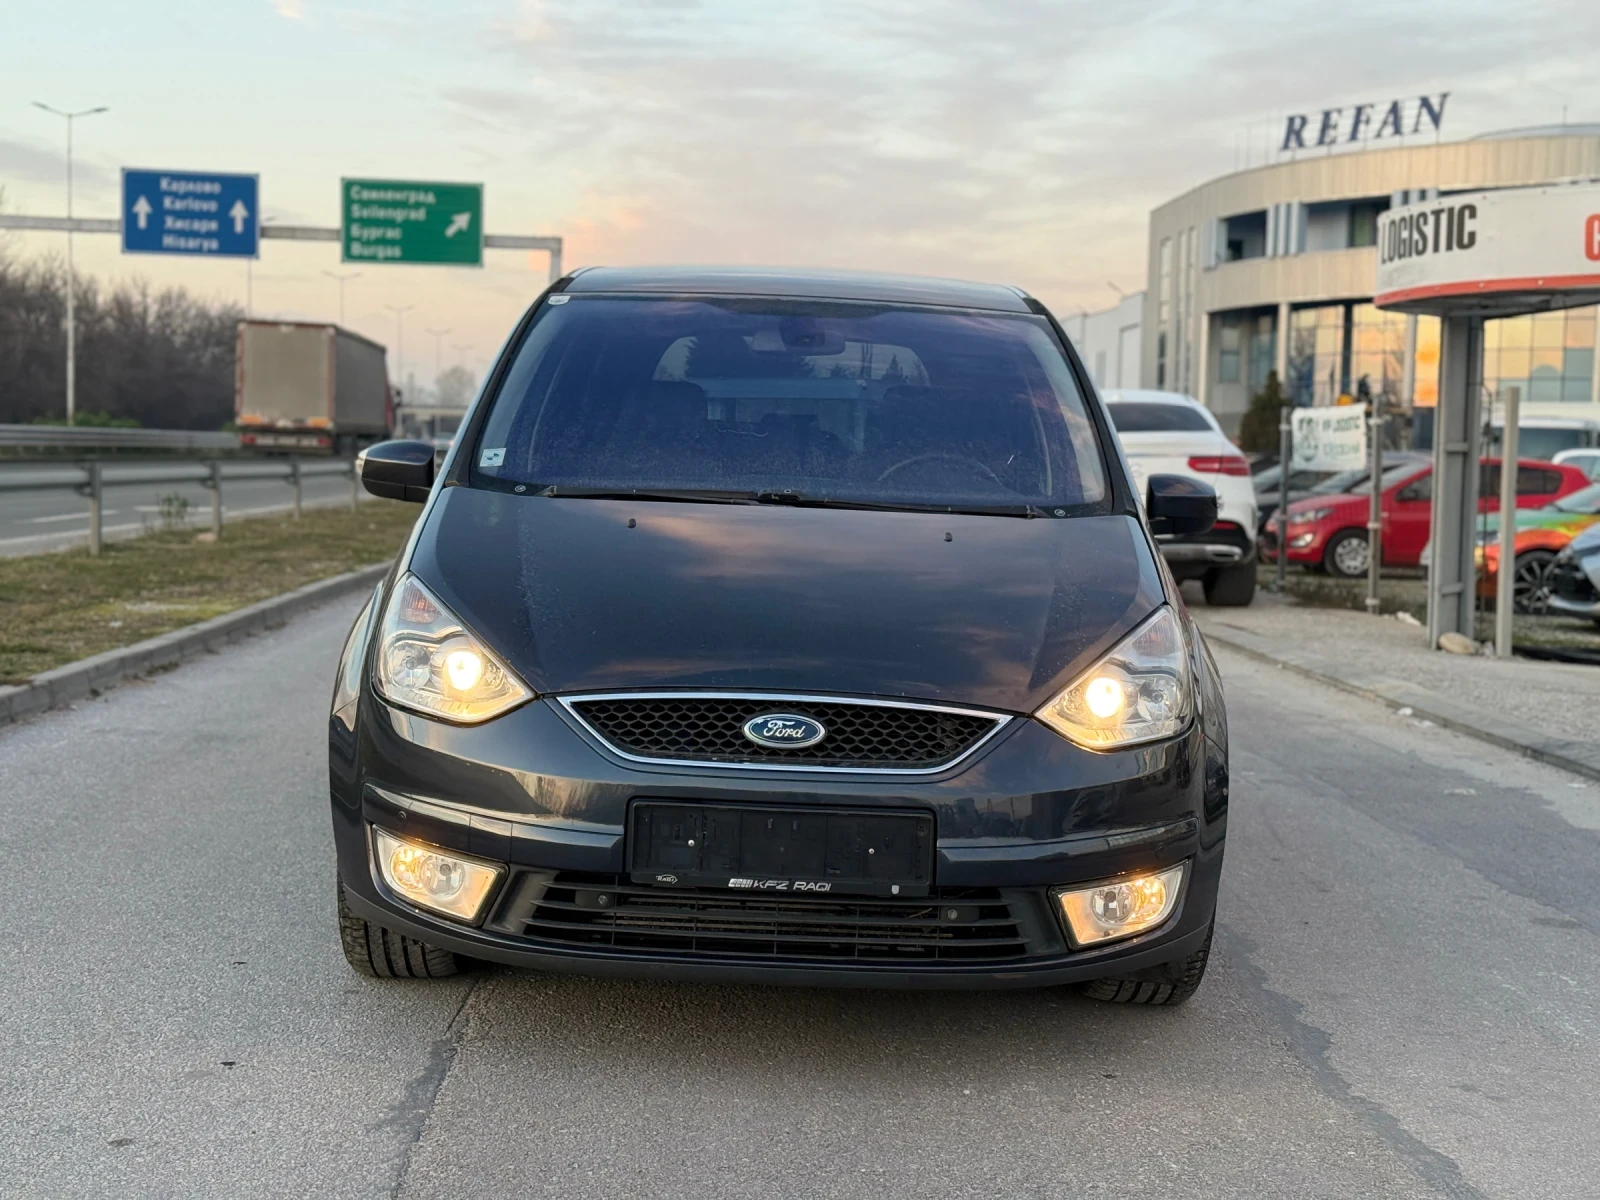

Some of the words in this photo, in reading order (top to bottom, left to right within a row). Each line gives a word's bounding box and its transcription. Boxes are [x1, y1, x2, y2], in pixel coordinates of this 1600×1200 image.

[1280, 92, 1451, 150] REFAN
[163, 195, 218, 212] Karlovo
[1381, 203, 1477, 265] LOGISTIC
[162, 234, 219, 253] Hisarya
[350, 241, 403, 259] Burgas
[763, 720, 806, 738] Ford
